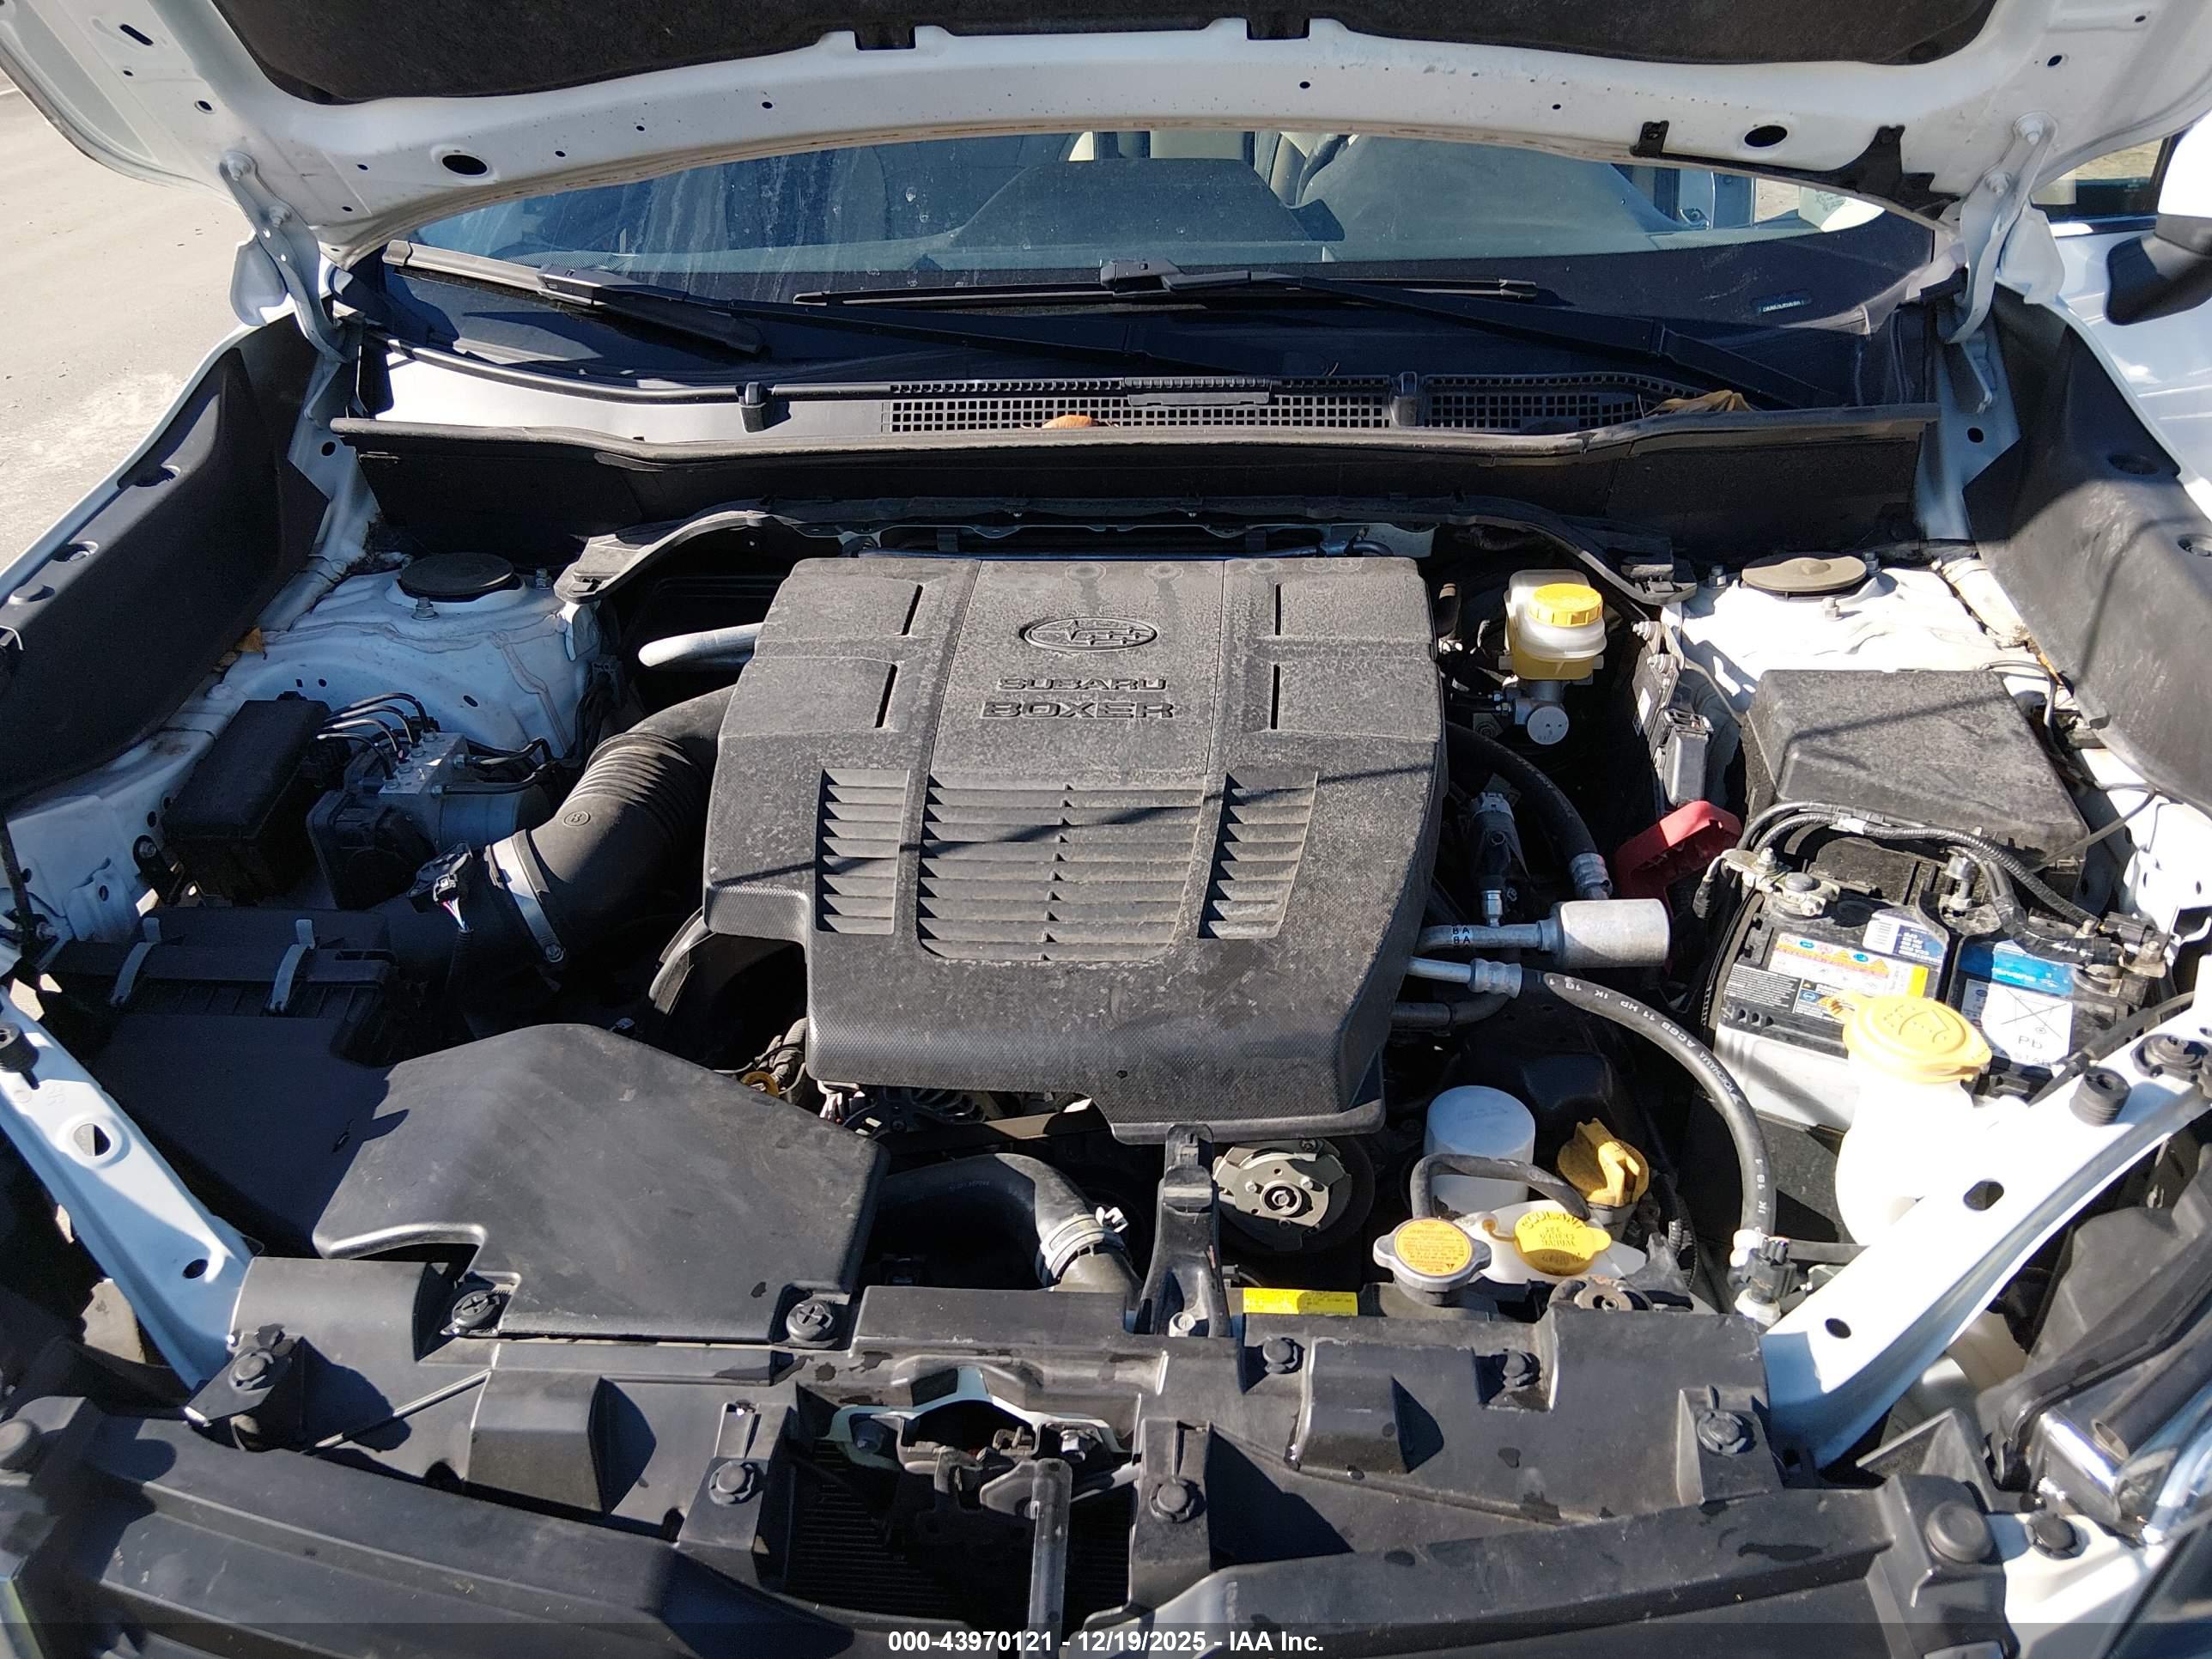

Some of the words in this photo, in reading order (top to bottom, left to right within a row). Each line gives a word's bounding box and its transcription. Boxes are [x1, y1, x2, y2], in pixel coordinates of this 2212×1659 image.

[997, 678, 1167, 690] SUBARU
[980, 701, 1174, 719] BOXER
[1699, 1051, 1735, 1093] YOKOHAMA
